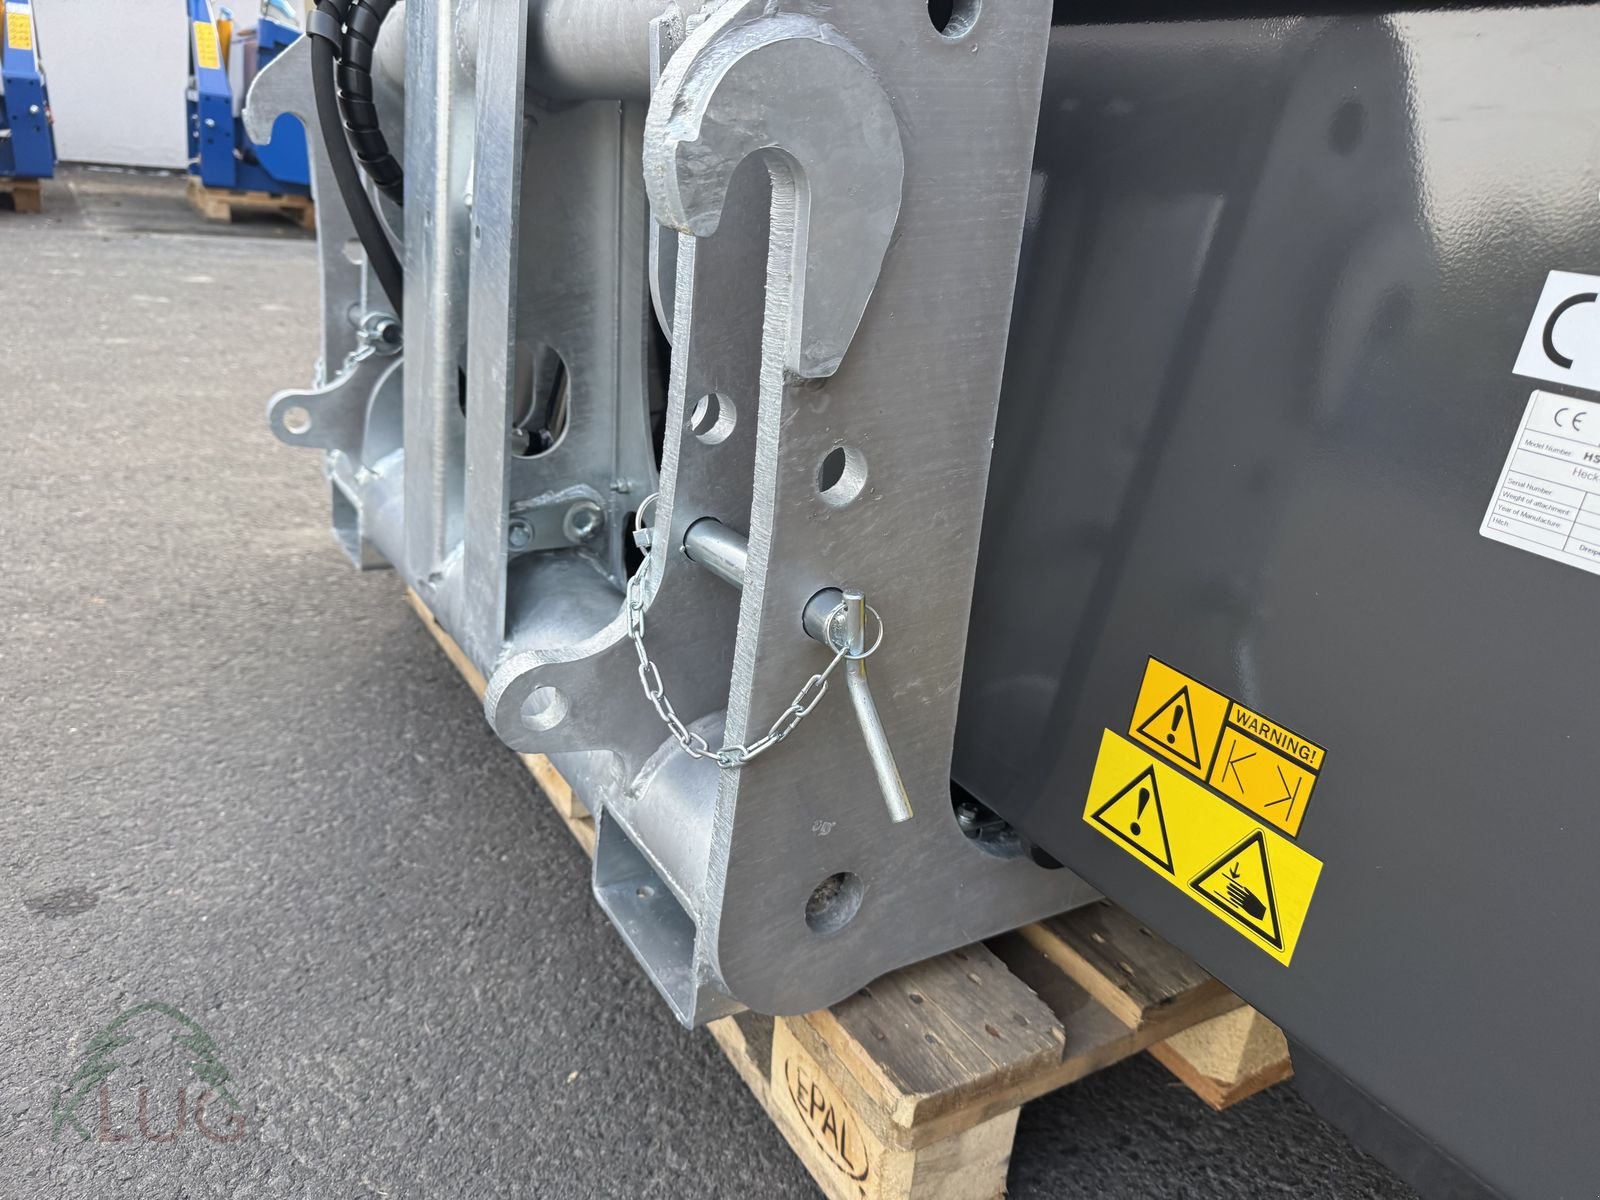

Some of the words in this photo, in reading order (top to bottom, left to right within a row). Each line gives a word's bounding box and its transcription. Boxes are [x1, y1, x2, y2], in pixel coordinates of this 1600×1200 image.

[1554, 407, 1588, 432] CE
[1507, 477, 1526, 488] Serial
[1502, 490, 1525, 502] Weight
[1525, 497, 1533, 505] of
[1498, 503, 1512, 513] Year
[1236, 709, 1317, 764] WARNING!
[797, 1066, 854, 1171] EPAL
